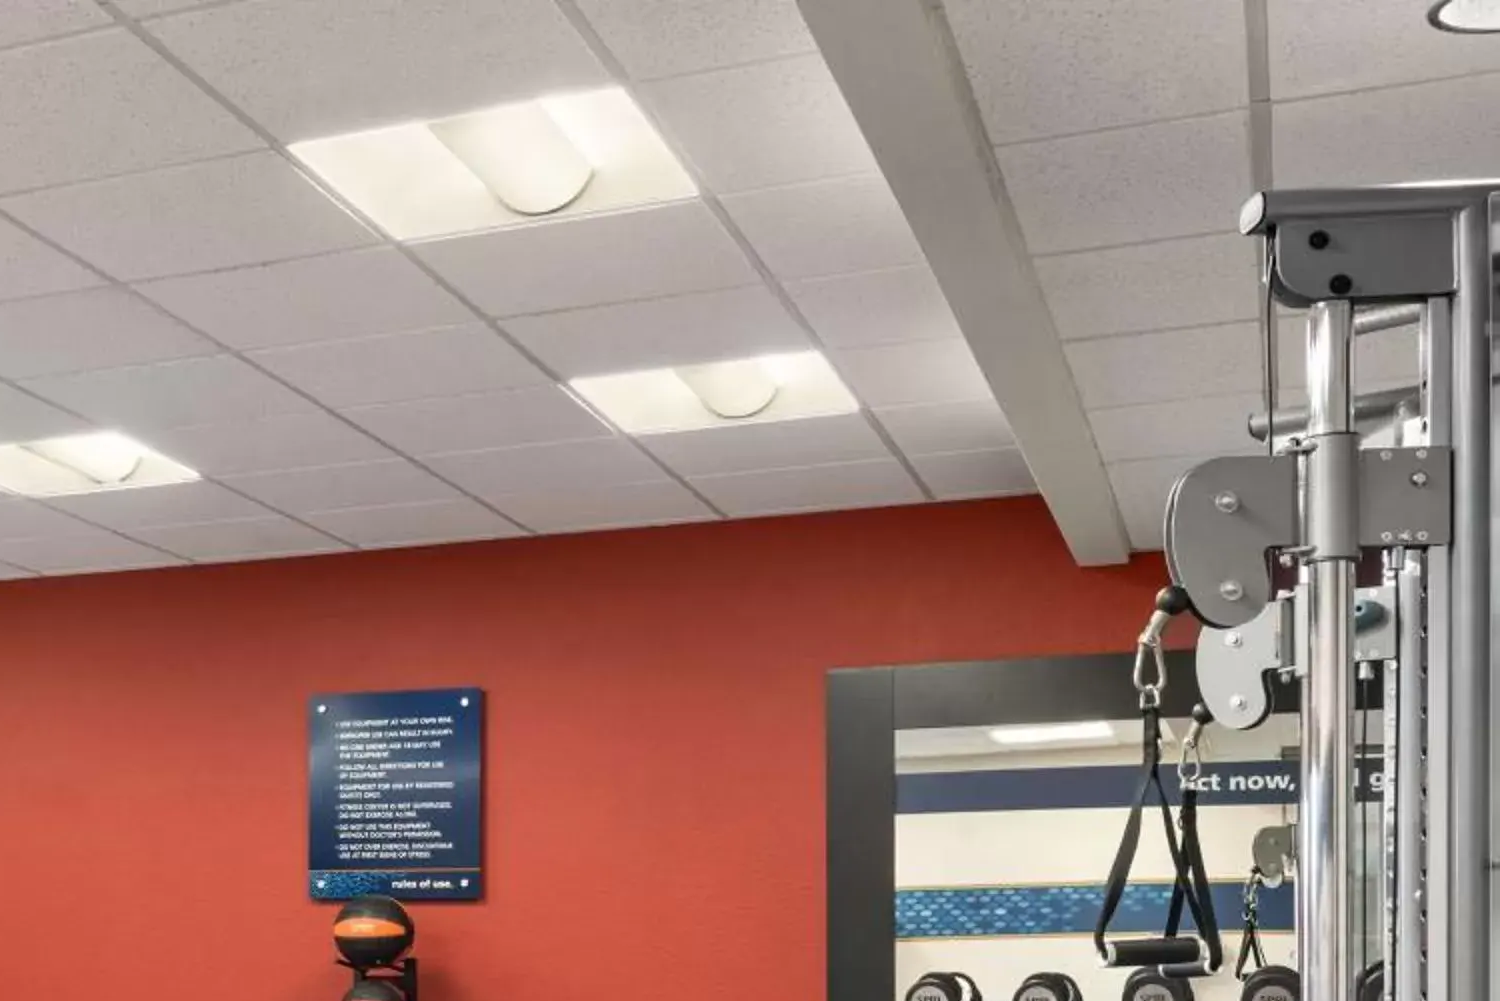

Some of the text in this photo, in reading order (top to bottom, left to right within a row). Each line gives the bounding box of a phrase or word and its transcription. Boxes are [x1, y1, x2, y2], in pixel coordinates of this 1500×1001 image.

[1229, 774, 1296, 792] now,
[391, 879, 454, 890] rules of use.
